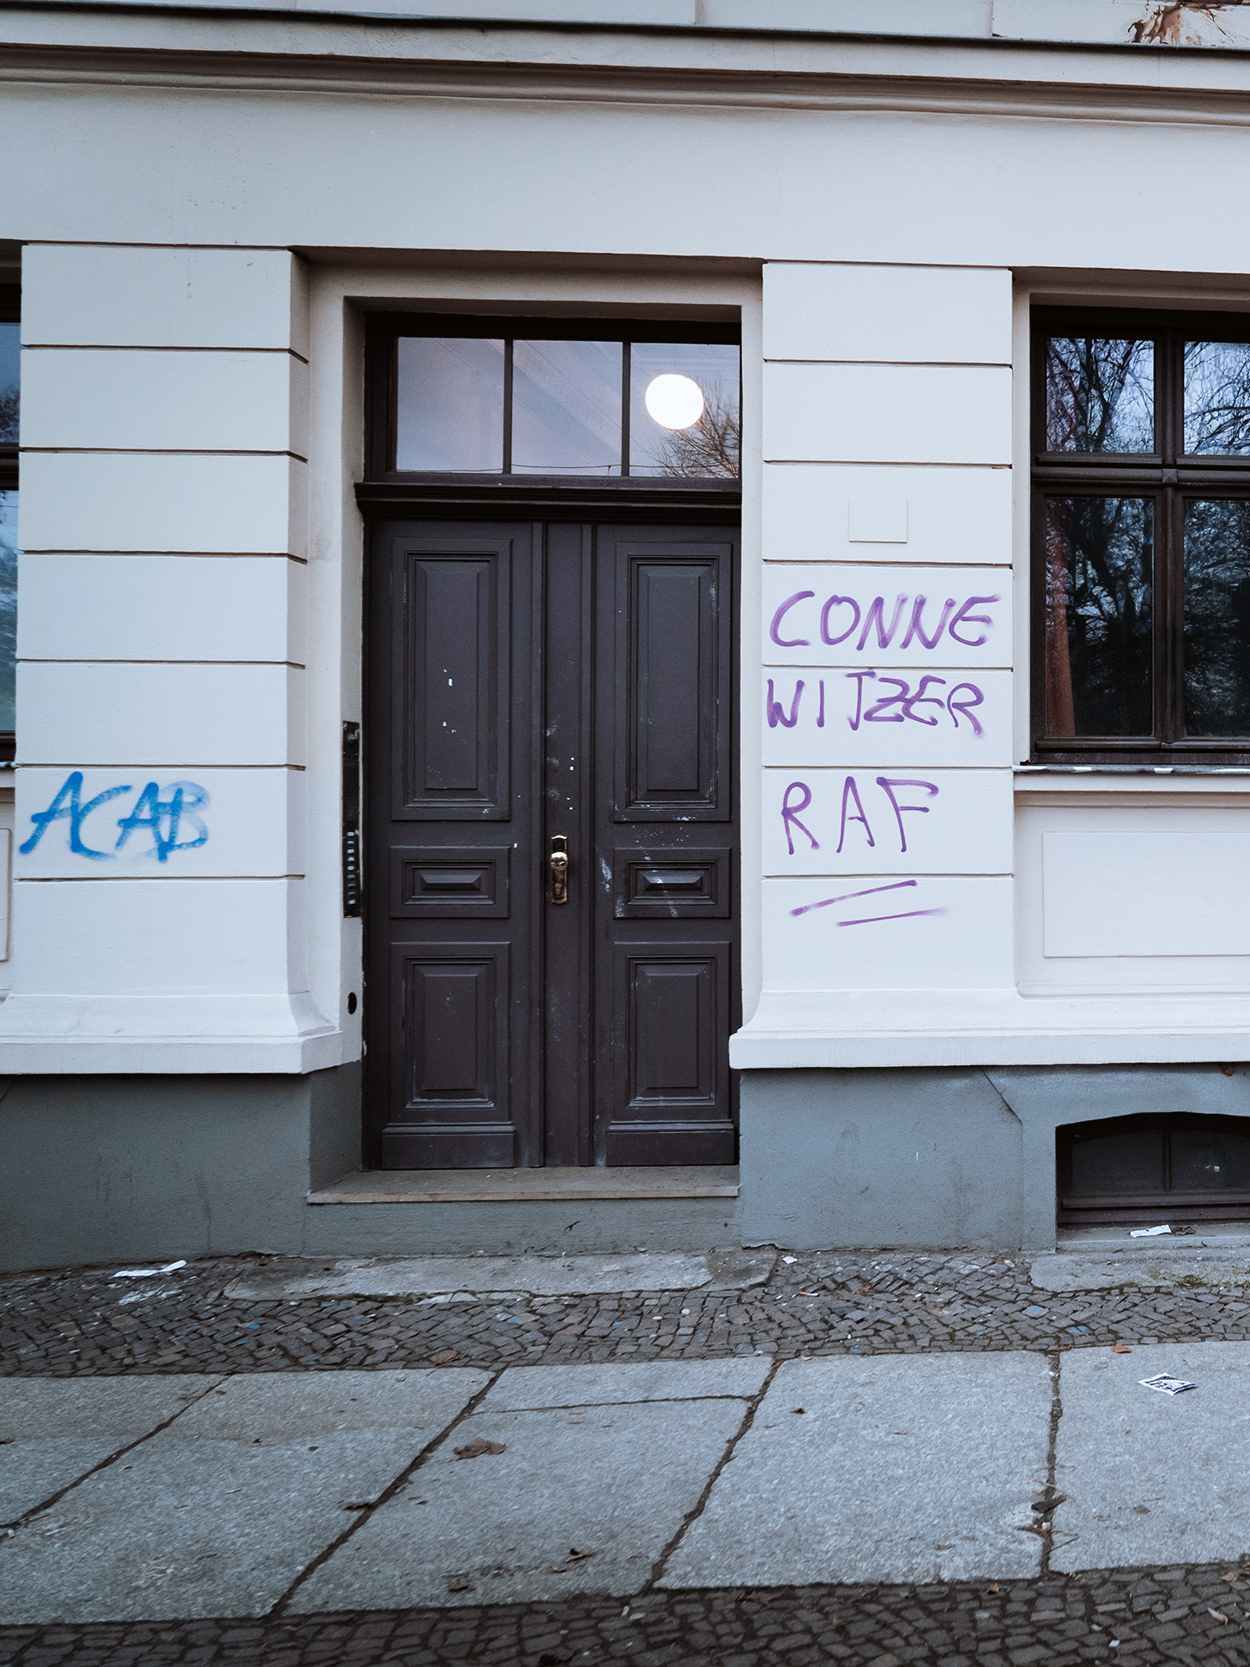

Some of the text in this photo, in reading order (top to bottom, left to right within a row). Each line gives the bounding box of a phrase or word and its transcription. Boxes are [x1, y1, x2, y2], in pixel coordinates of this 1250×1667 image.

[770, 590, 1000, 650] CONNE
[767, 667, 984, 736] WITZER
[18, 771, 211, 864] ACAB
[781, 776, 939, 855] RAF
